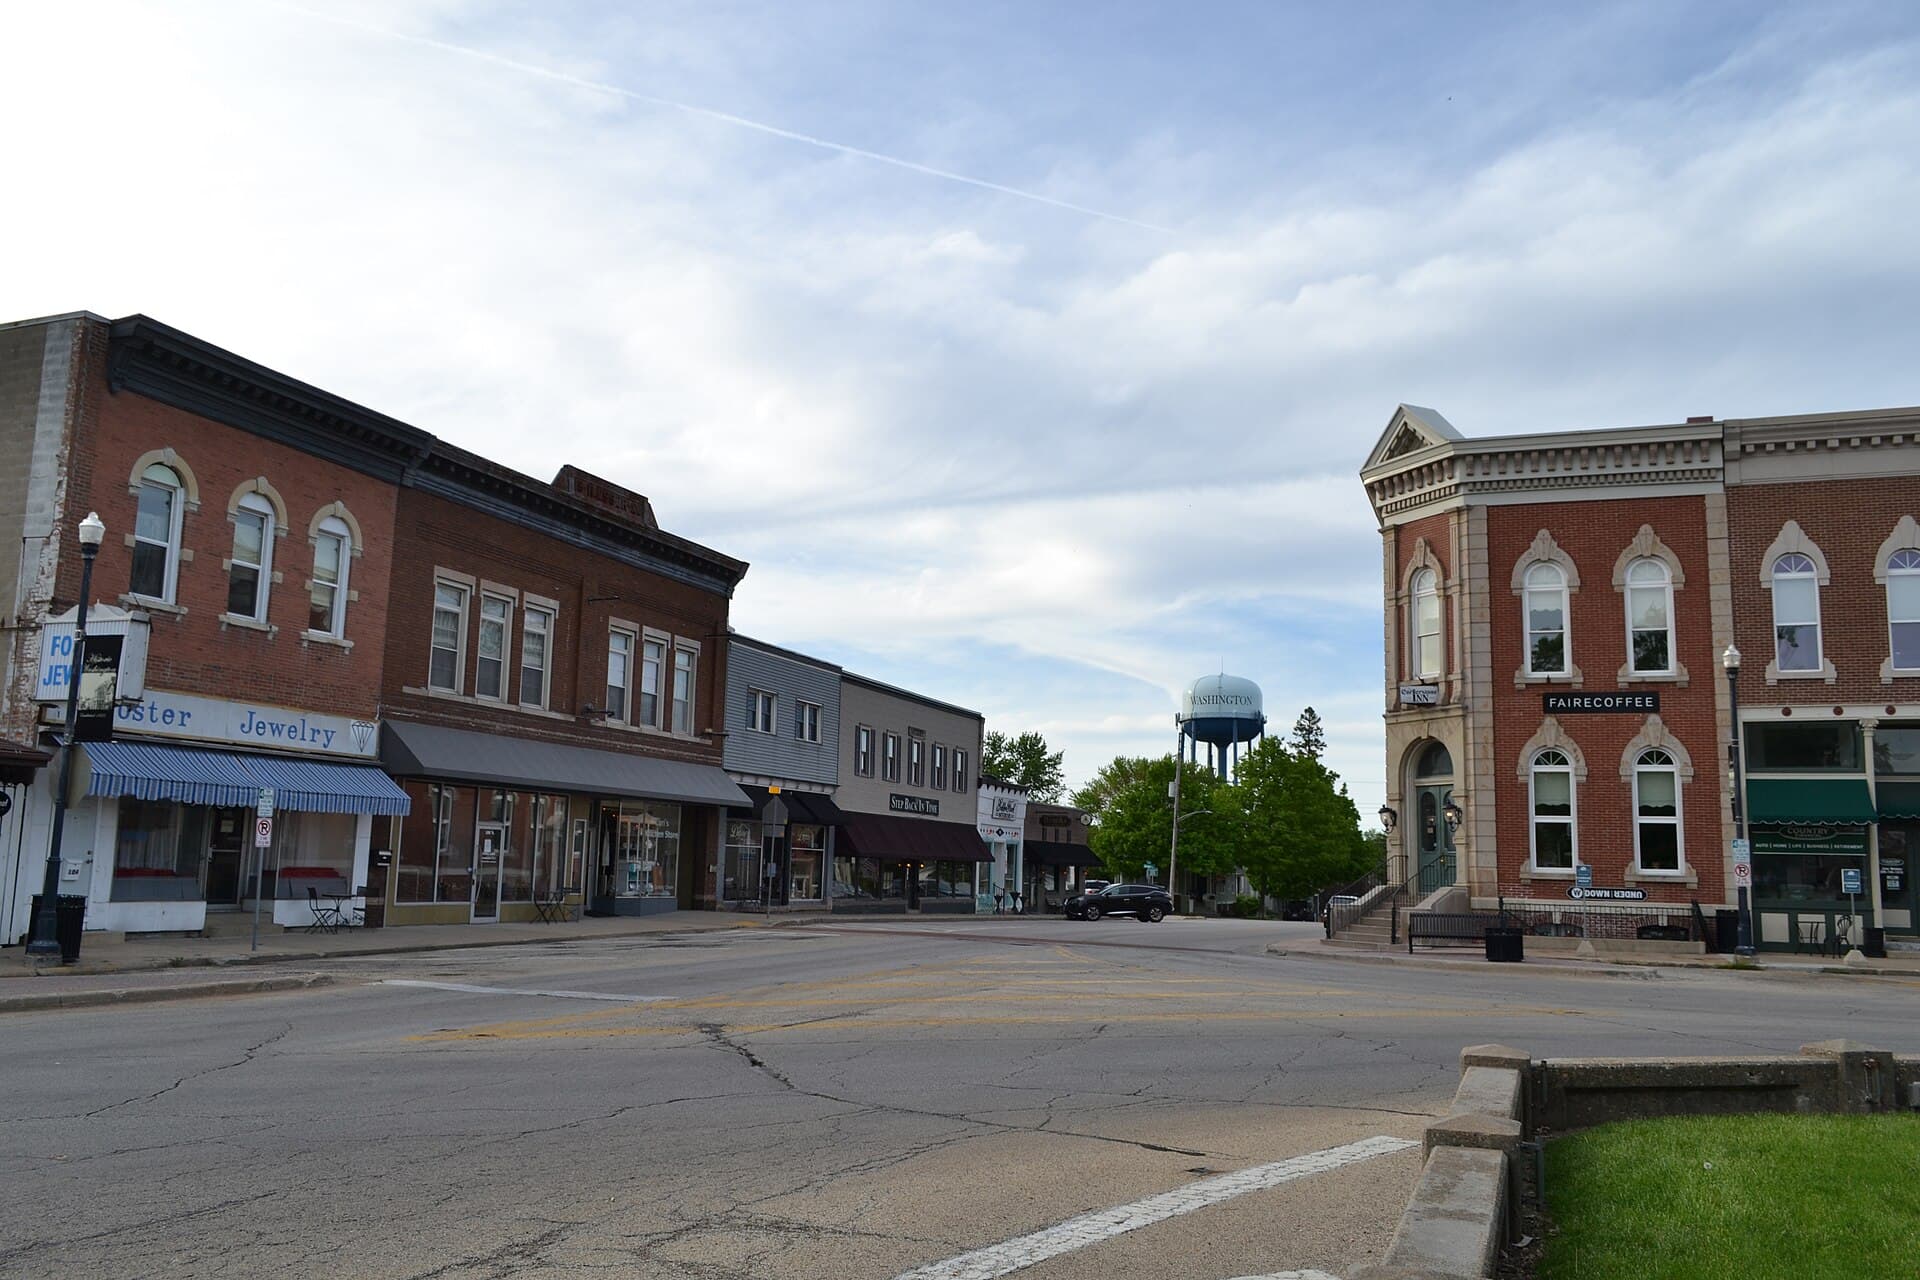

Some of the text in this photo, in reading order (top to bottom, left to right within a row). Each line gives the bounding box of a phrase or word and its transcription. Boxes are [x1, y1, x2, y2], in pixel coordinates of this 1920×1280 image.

[1190, 695, 1254, 705] WASHINGTON
[1412, 694, 1429, 702] INN
[1549, 697, 1654, 708] FAIRECOFFEE
[117, 701, 337, 749] oster Jewelry
[891, 795, 905, 809] STEP
[1787, 825, 1829, 835] COUNTRY
[1584, 889, 1611, 898] DOWN
[1613, 890, 1643, 899] UNDER
